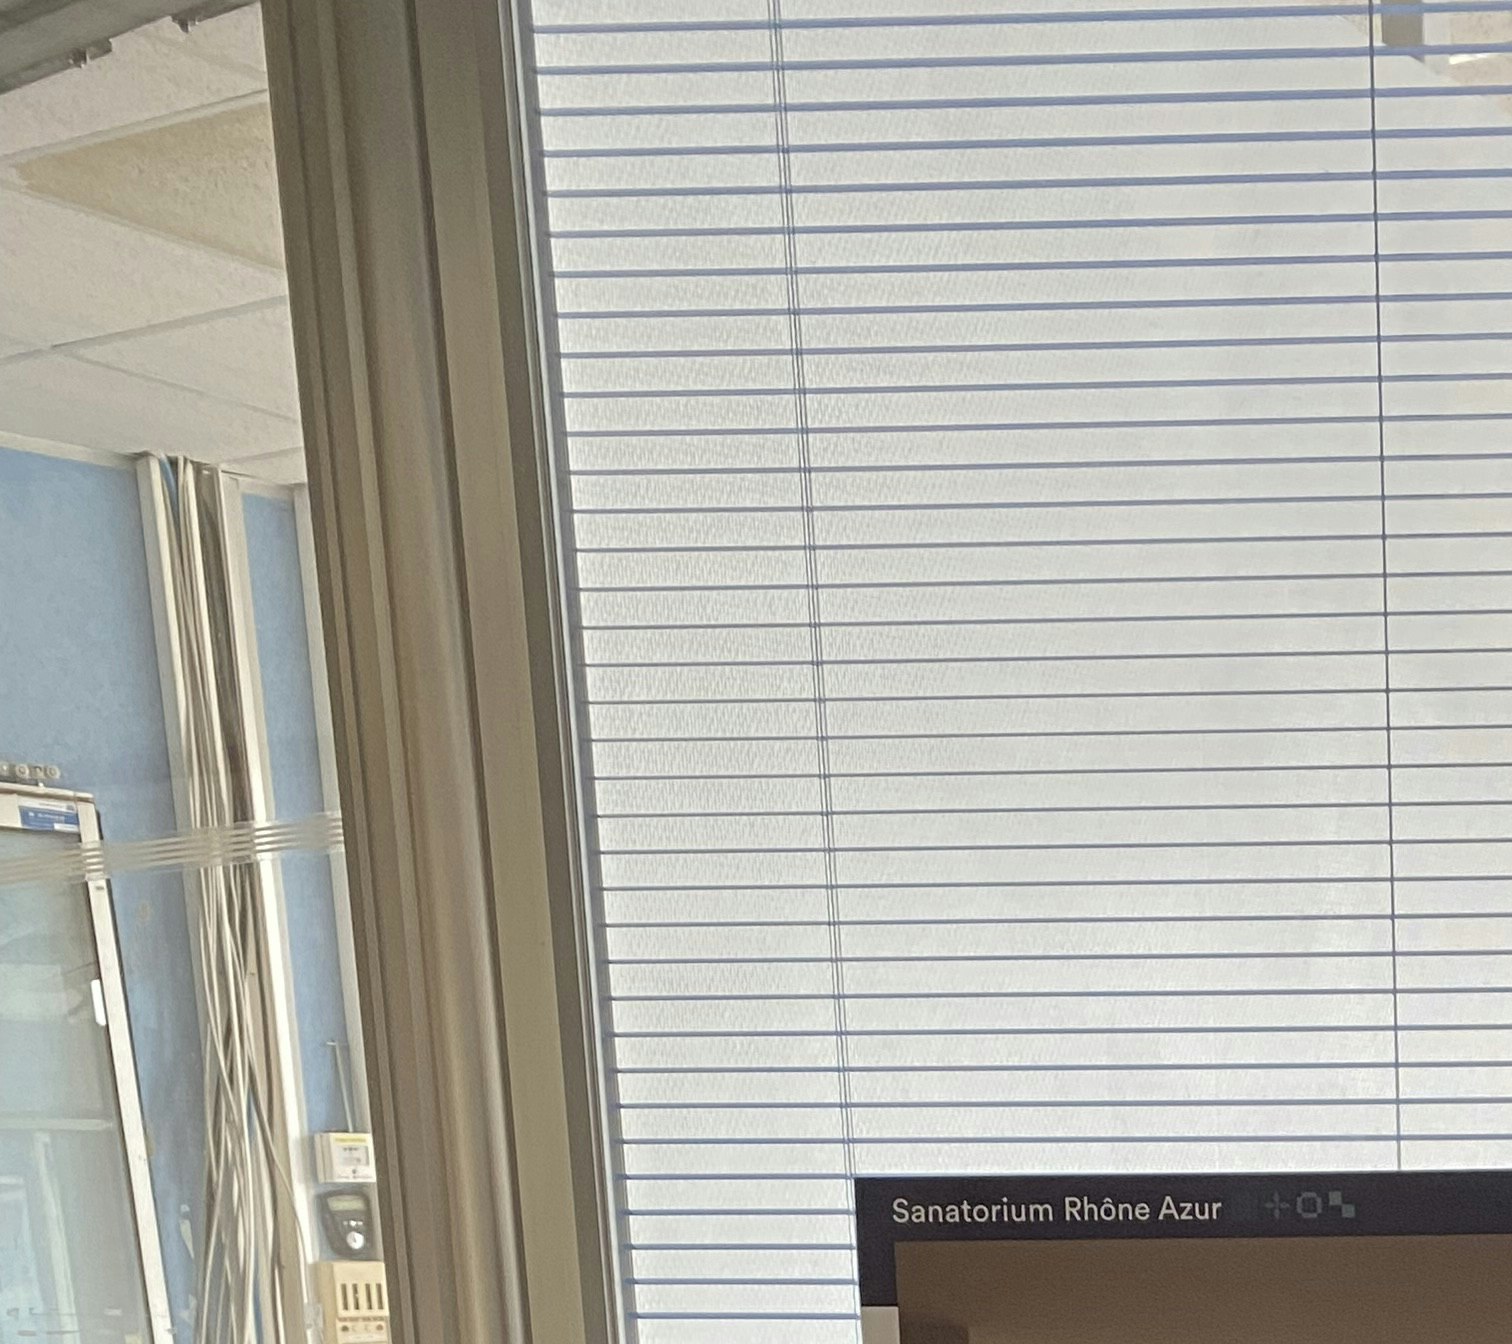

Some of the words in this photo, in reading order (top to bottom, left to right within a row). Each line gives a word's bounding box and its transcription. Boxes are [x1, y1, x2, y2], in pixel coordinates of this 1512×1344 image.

[892, 1196, 1054, 1224] Sanatorium
[1064, 1195, 1151, 1222] Rhône
[1158, 1195, 1222, 1221] Azur
